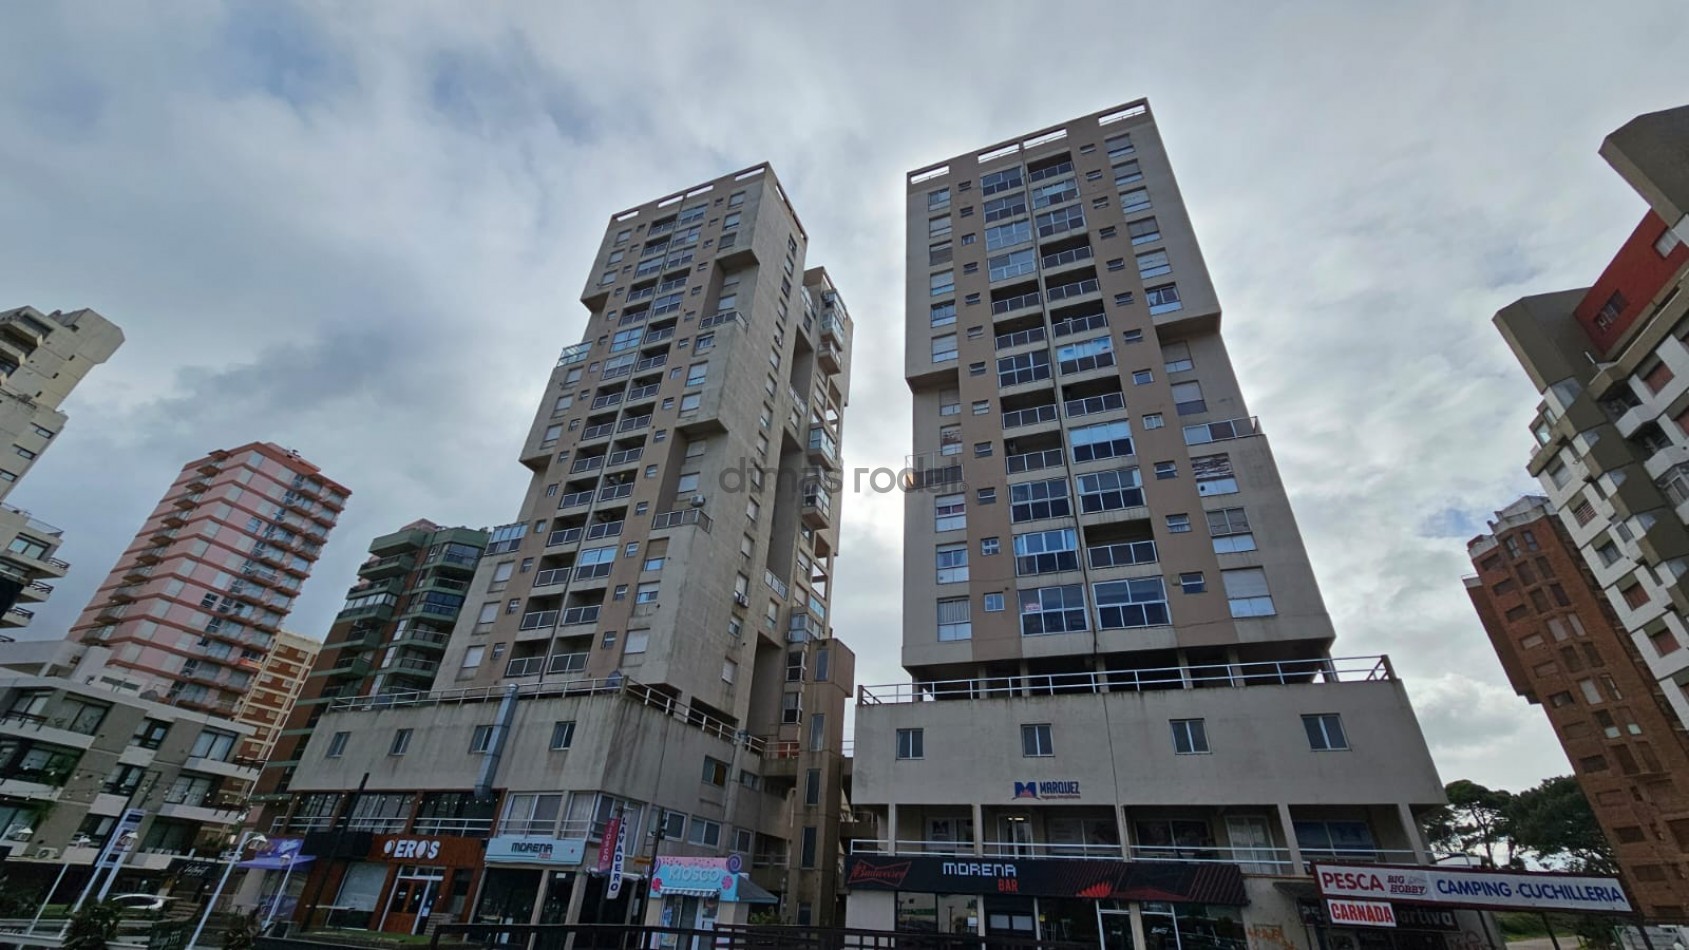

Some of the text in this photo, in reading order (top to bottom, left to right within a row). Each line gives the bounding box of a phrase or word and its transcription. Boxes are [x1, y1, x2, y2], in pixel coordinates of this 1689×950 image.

[1039, 781, 1080, 794] MARQUEZ
[511, 842, 553, 853] MORENA
[610, 817, 627, 891] LAVADERO
[668, 866, 720, 881] KIOSCO
[942, 861, 1017, 877] MORENA
[997, 878, 1019, 893] BAR
[1321, 872, 1385, 892] PESCA
[1387, 875, 1405, 884] BIG
[1389, 884, 1426, 895] HOBBY
[1436, 879, 1512, 898] CAMPING
[1330, 902, 1394, 923] CARNADA
